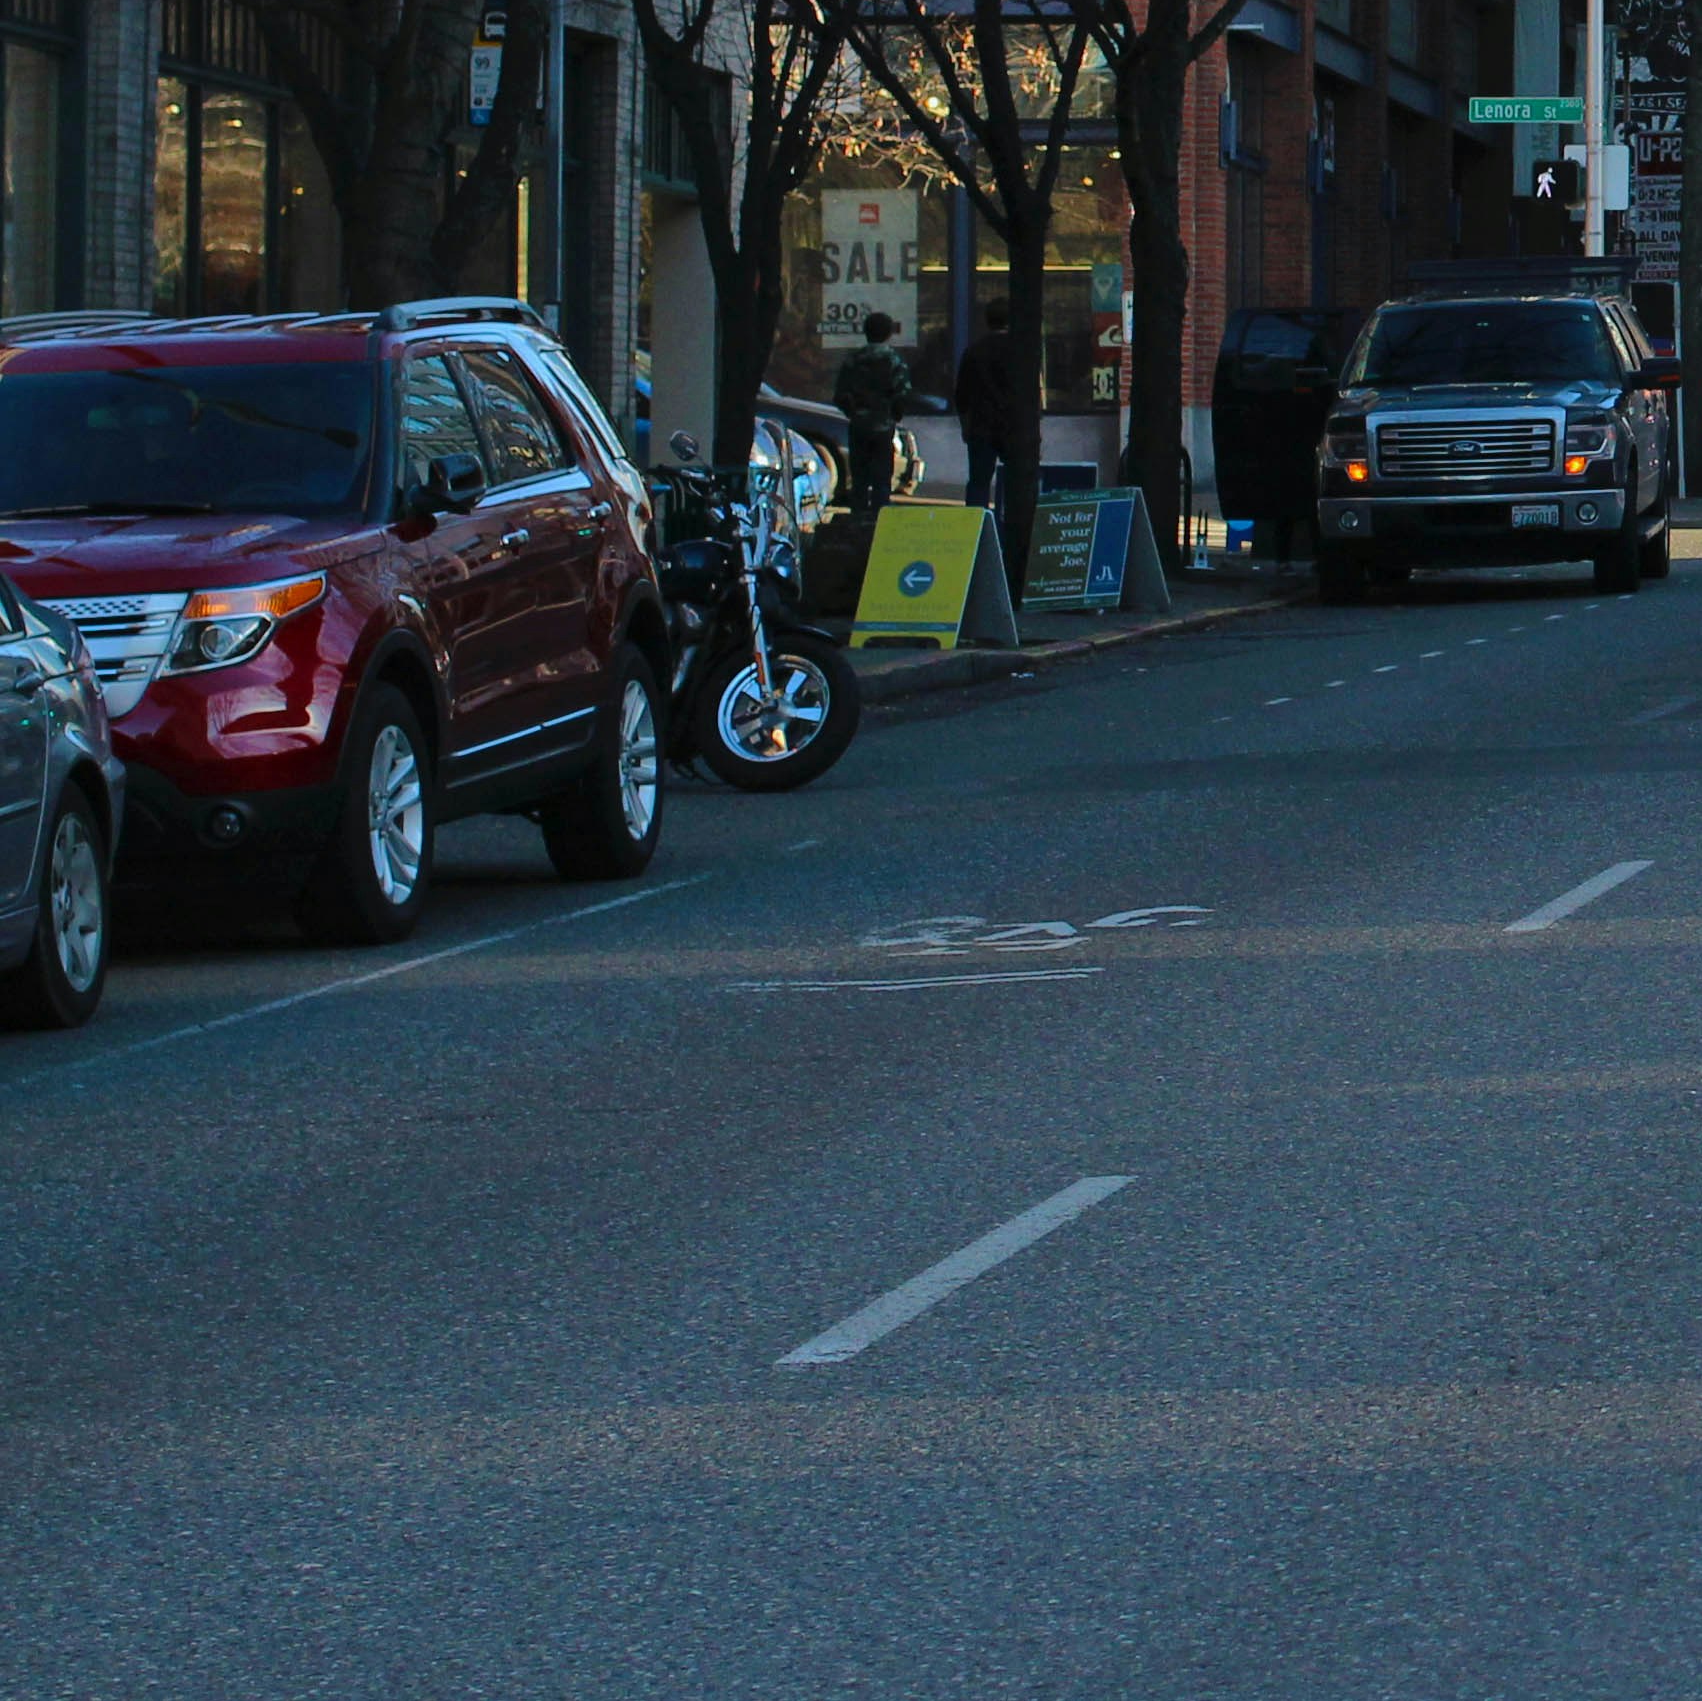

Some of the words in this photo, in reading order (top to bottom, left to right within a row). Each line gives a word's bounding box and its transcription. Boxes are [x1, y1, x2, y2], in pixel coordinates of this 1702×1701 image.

[1474, 100, 1531, 119] Lenora
[1543, 106, 1557, 119] St
[823, 241, 918, 284] SALE
[1049, 512, 1071, 525] Not
[1075, 511, 1094, 523] for
[1060, 528, 1091, 541] your
[1040, 542, 1089, 555] average
[1060, 555, 1086, 568] Joe.
